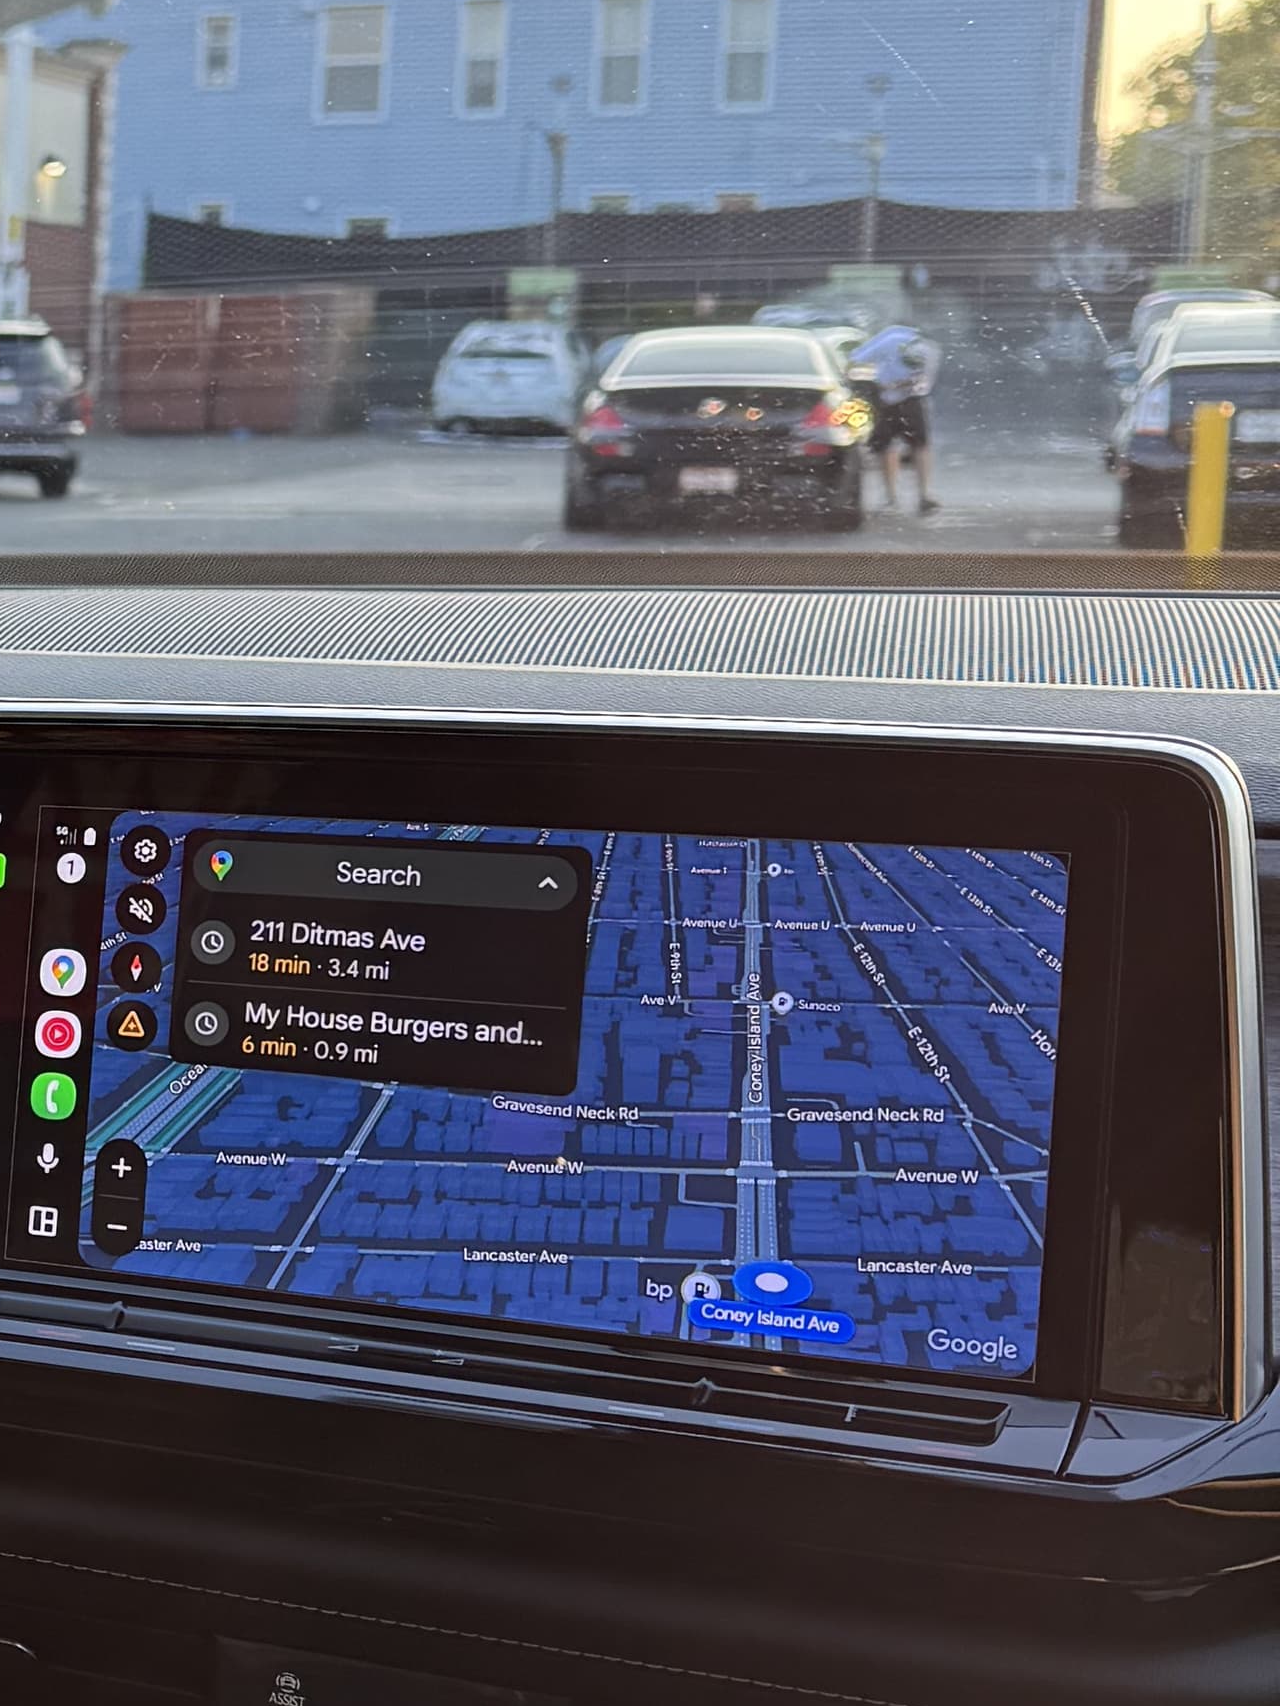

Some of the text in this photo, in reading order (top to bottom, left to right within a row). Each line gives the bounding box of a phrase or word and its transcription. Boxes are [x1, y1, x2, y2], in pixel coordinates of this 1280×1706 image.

[336, 861, 421, 887] Search
[960, 887, 968, 896] E
[982, 905, 993, 916] St
[1055, 906, 1067, 916] St
[682, 918, 738, 929] Avenue U
[774, 919, 830, 931] Avenue U
[860, 921, 916, 933] Avenue U
[115, 932, 127, 945] St
[250, 920, 426, 952] 211 Ditmas Ave
[670, 952, 681, 971] 9th
[1037, 948, 1047, 959] E
[248, 953, 390, 981] 18 min 3.4 mi
[853, 943, 887, 986] E 12th St
[671, 971, 682, 985] St
[640, 995, 678, 1006] Ave V
[988, 1003, 1027, 1015] Ave V
[244, 1001, 543, 1046] My House Burgers and...
[747, 972, 765, 1103] Coney Island Ave
[242, 1036, 379, 1064] 6 min 0.9 mi
[907, 1025, 950, 1084] E 12th St
[492, 1095, 639, 1120] Gravesend Neck Rd
[787, 1107, 944, 1122] Gravesend Neck Rd
[217, 1151, 287, 1166] Avenue W
[507, 1160, 584, 1174] Avenue W
[895, 1168, 979, 1183] Avenue W
[135, 1239, 201, 1253] aster Ave
[463, 1248, 568, 1264] Lancaster Ave
[857, 1257, 973, 1275] Lancaster Ave
[646, 1279, 673, 1301] bp
[701, 1303, 840, 1334] Coney Island Ave
[927, 1329, 1018, 1363] Google
